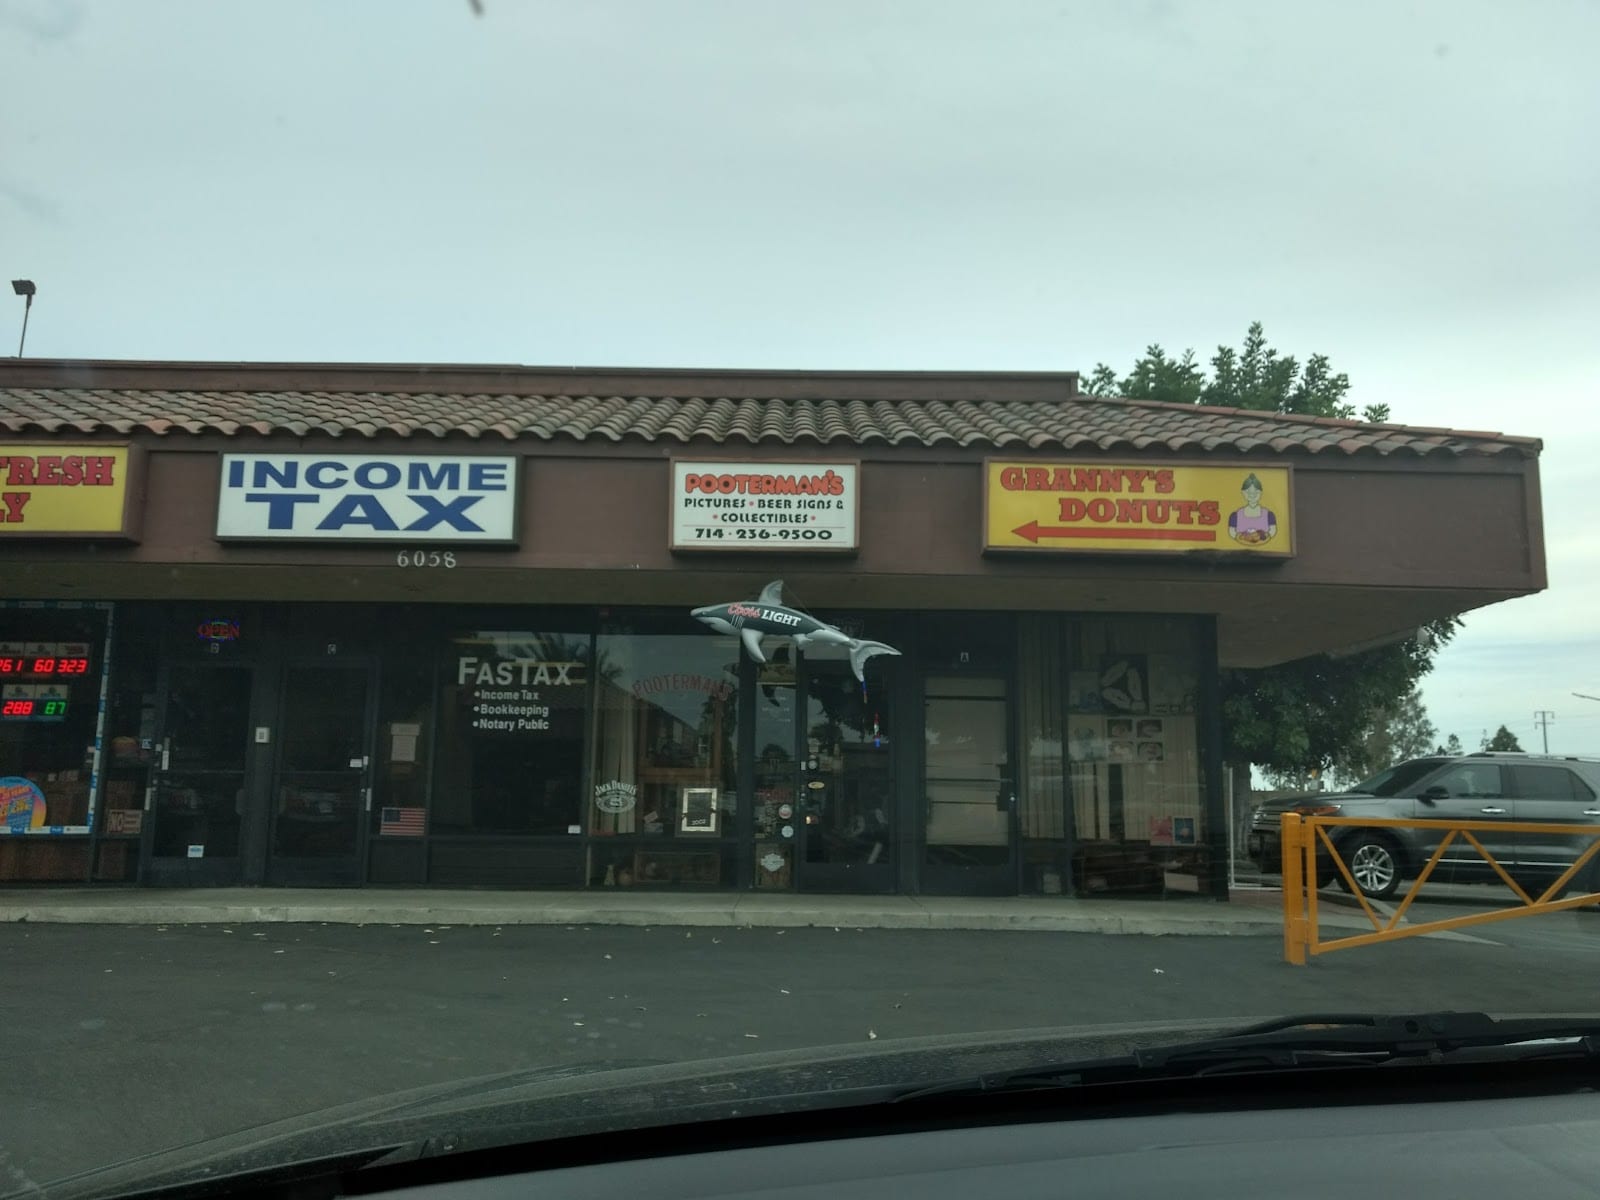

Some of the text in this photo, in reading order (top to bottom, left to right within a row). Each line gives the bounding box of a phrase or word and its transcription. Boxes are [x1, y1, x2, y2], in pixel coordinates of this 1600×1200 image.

[228, 460, 507, 491] INCOME
[1000, 467, 1175, 494] GRANNY'S
[685, 470, 844, 496] POOTERMAN'S
[0, 492, 31, 523] Y
[684, 498, 844, 510] PICTURES BEER SIGNS &
[245, 492, 487, 532] TAX
[721, 513, 808, 524] COLLECTIBLES
[1059, 497, 1221, 526] DONUTS
[695, 528, 833, 540] 714 236-9500
[397, 550, 457, 569] 6058
[761, 609, 802, 627] LIGHT
[197, 624, 241, 638] OPEN
[33, 659, 55, 673] 60
[57, 659, 89, 673] 323
[481, 689, 539, 701] Income Tax
[2, 701, 34, 715] 288
[44, 701, 67, 715] 87
[480, 704, 549, 718] Bookkeeping
[479, 718, 549, 732] Notary Public
